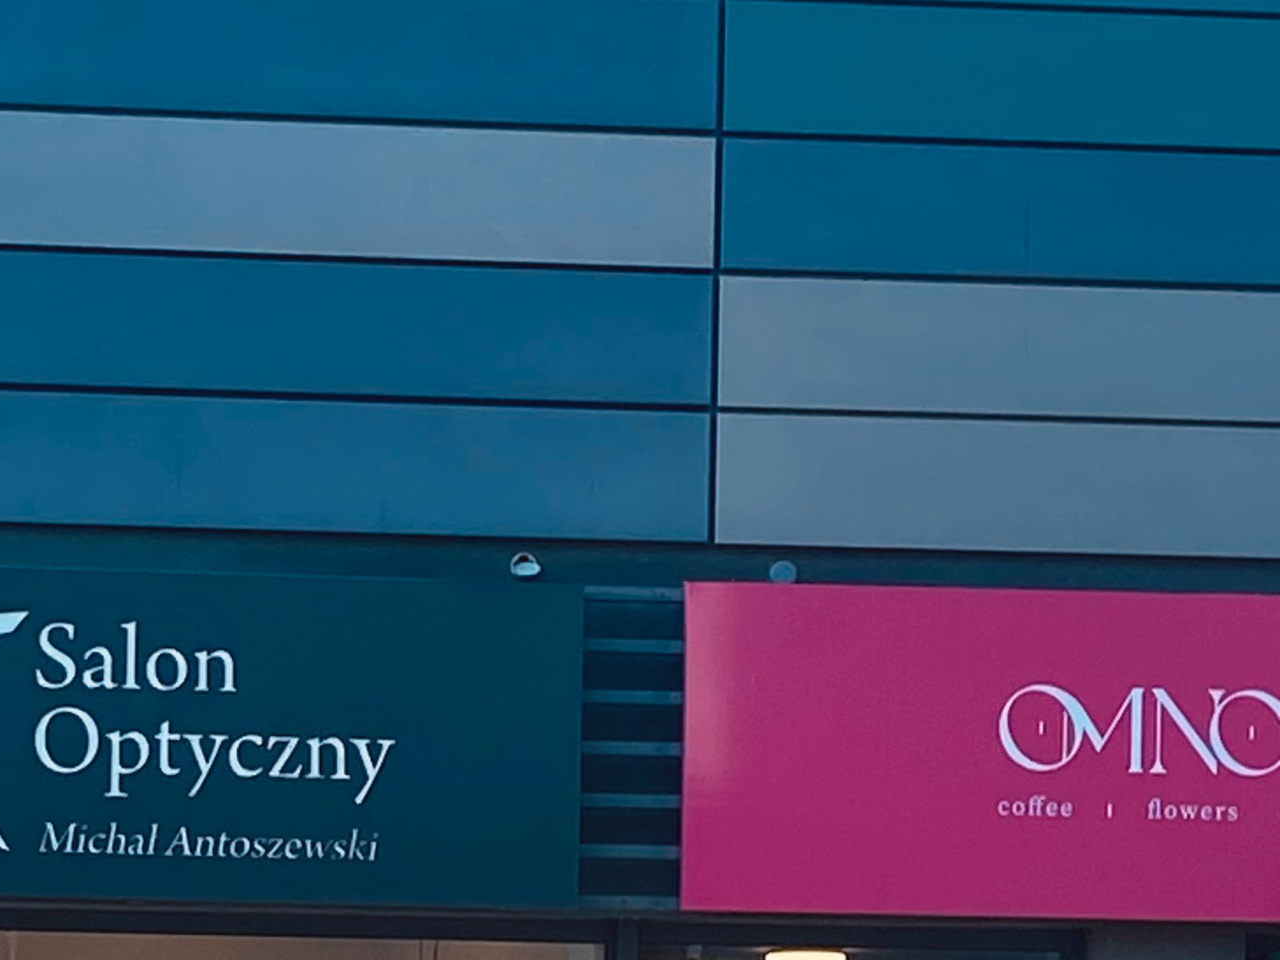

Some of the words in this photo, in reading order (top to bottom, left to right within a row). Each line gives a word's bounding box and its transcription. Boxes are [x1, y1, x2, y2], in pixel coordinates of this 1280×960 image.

[35, 621, 237, 693] Salon
[34, 706, 396, 805] Optyczny
[997, 795, 1074, 818] coffee
[1147, 797, 1239, 821] flowers
[164, 826, 380, 862] Antoszewski
